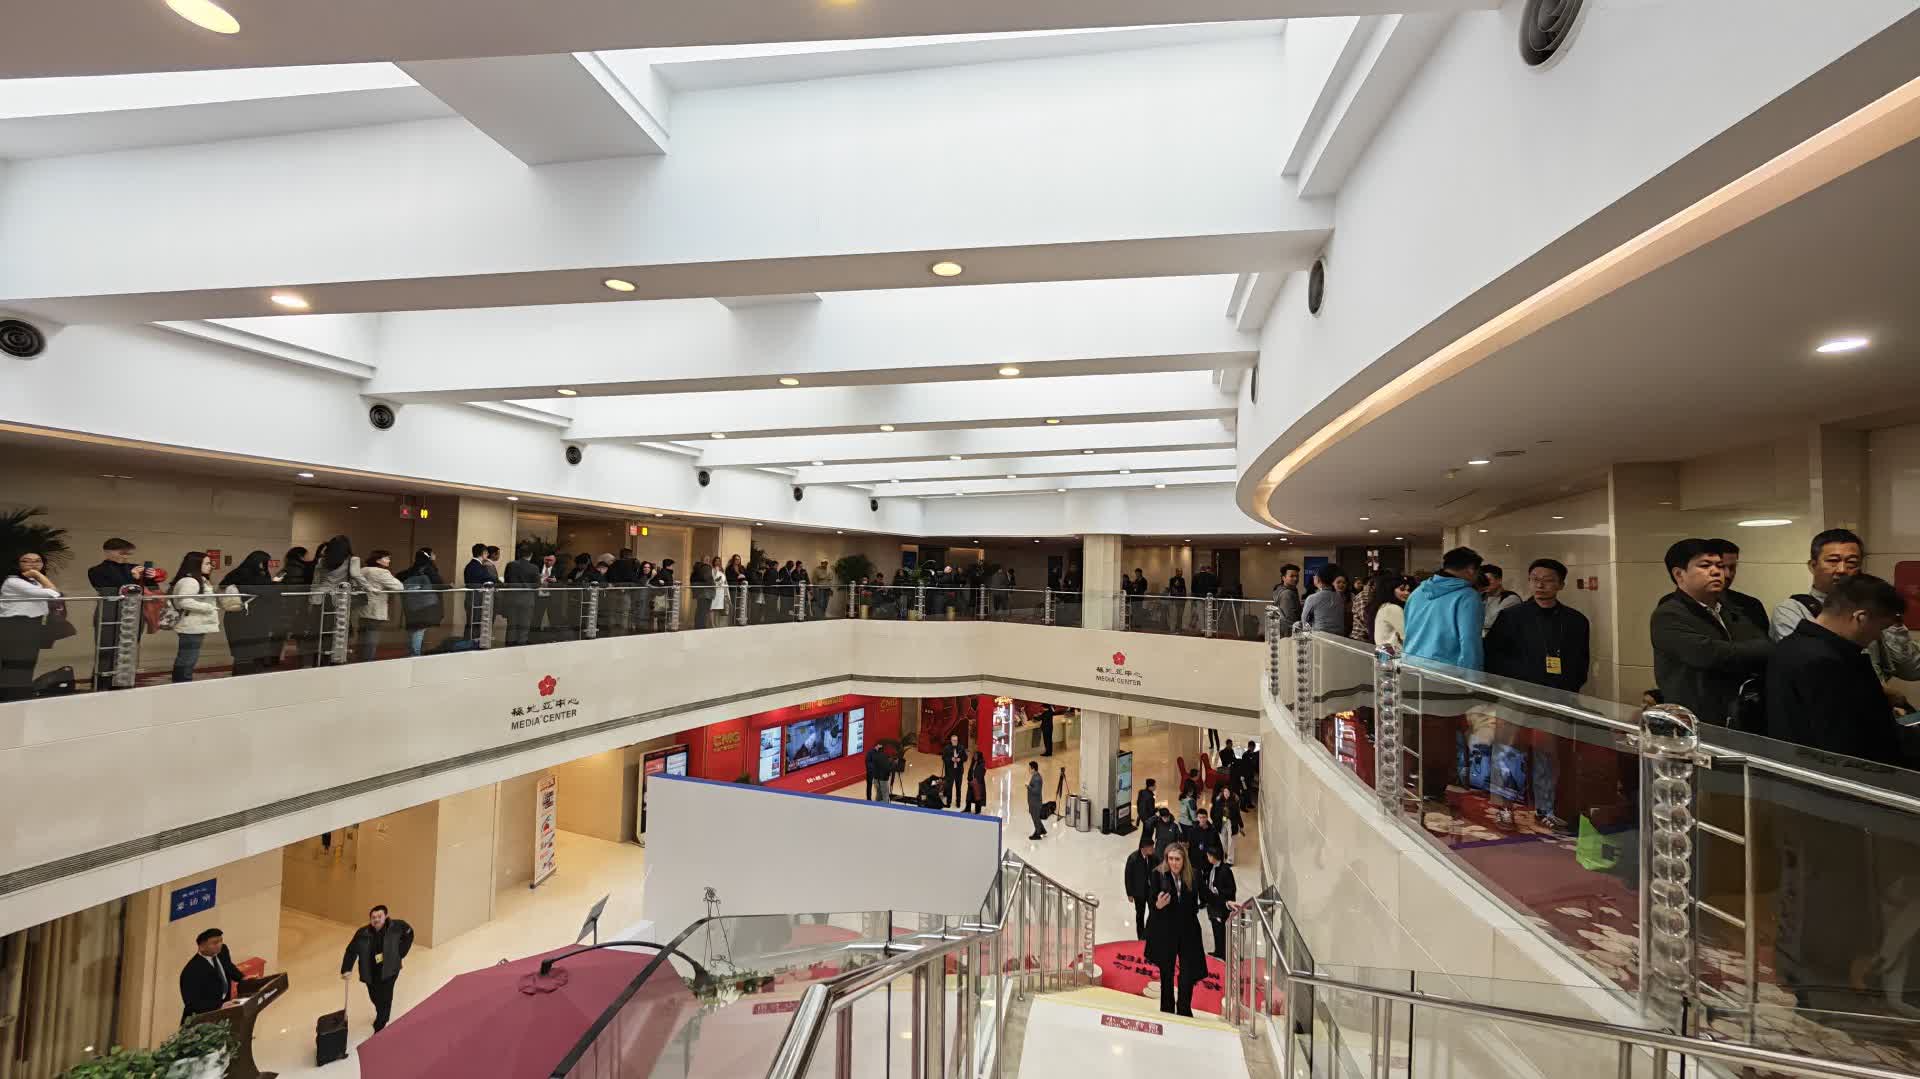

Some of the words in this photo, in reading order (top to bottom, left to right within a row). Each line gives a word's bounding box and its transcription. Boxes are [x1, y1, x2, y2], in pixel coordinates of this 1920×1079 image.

[1096, 675, 1115, 683] MEDIA
[1117, 677, 1141, 686] CENTER
[511, 716, 540, 730] MEDIA
[543, 709, 577, 723] CENTER
